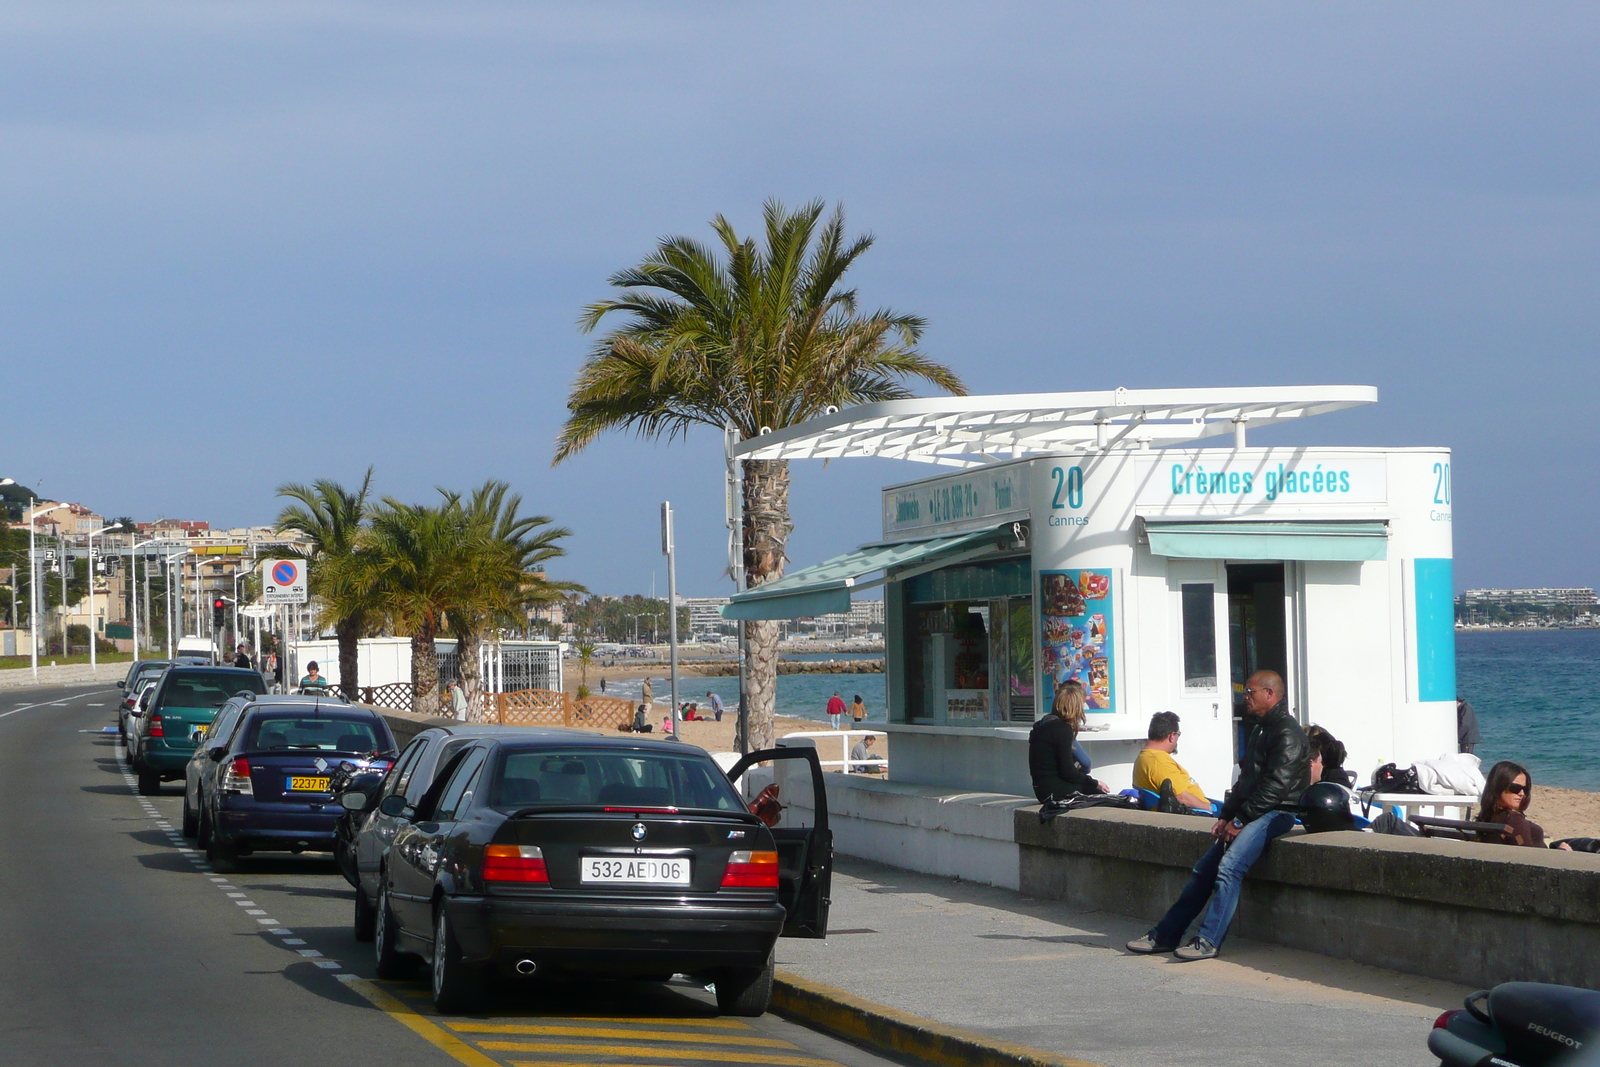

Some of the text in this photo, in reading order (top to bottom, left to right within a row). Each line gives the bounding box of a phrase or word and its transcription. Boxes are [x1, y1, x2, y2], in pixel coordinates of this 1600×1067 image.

[1051, 466, 1083, 509] 20
[1171, 463, 1350, 501] Crèmes glacées
[1433, 462, 1450, 505] 20
[952, 485, 963, 519] SUR
[965, 483, 973, 516] 20
[1048, 515, 1089, 526] Cannes
[292, 778, 316, 789] 2237
[591, 861, 681, 879] 532 AED 06
[1527, 1022, 1583, 1049] PEUGEOT
